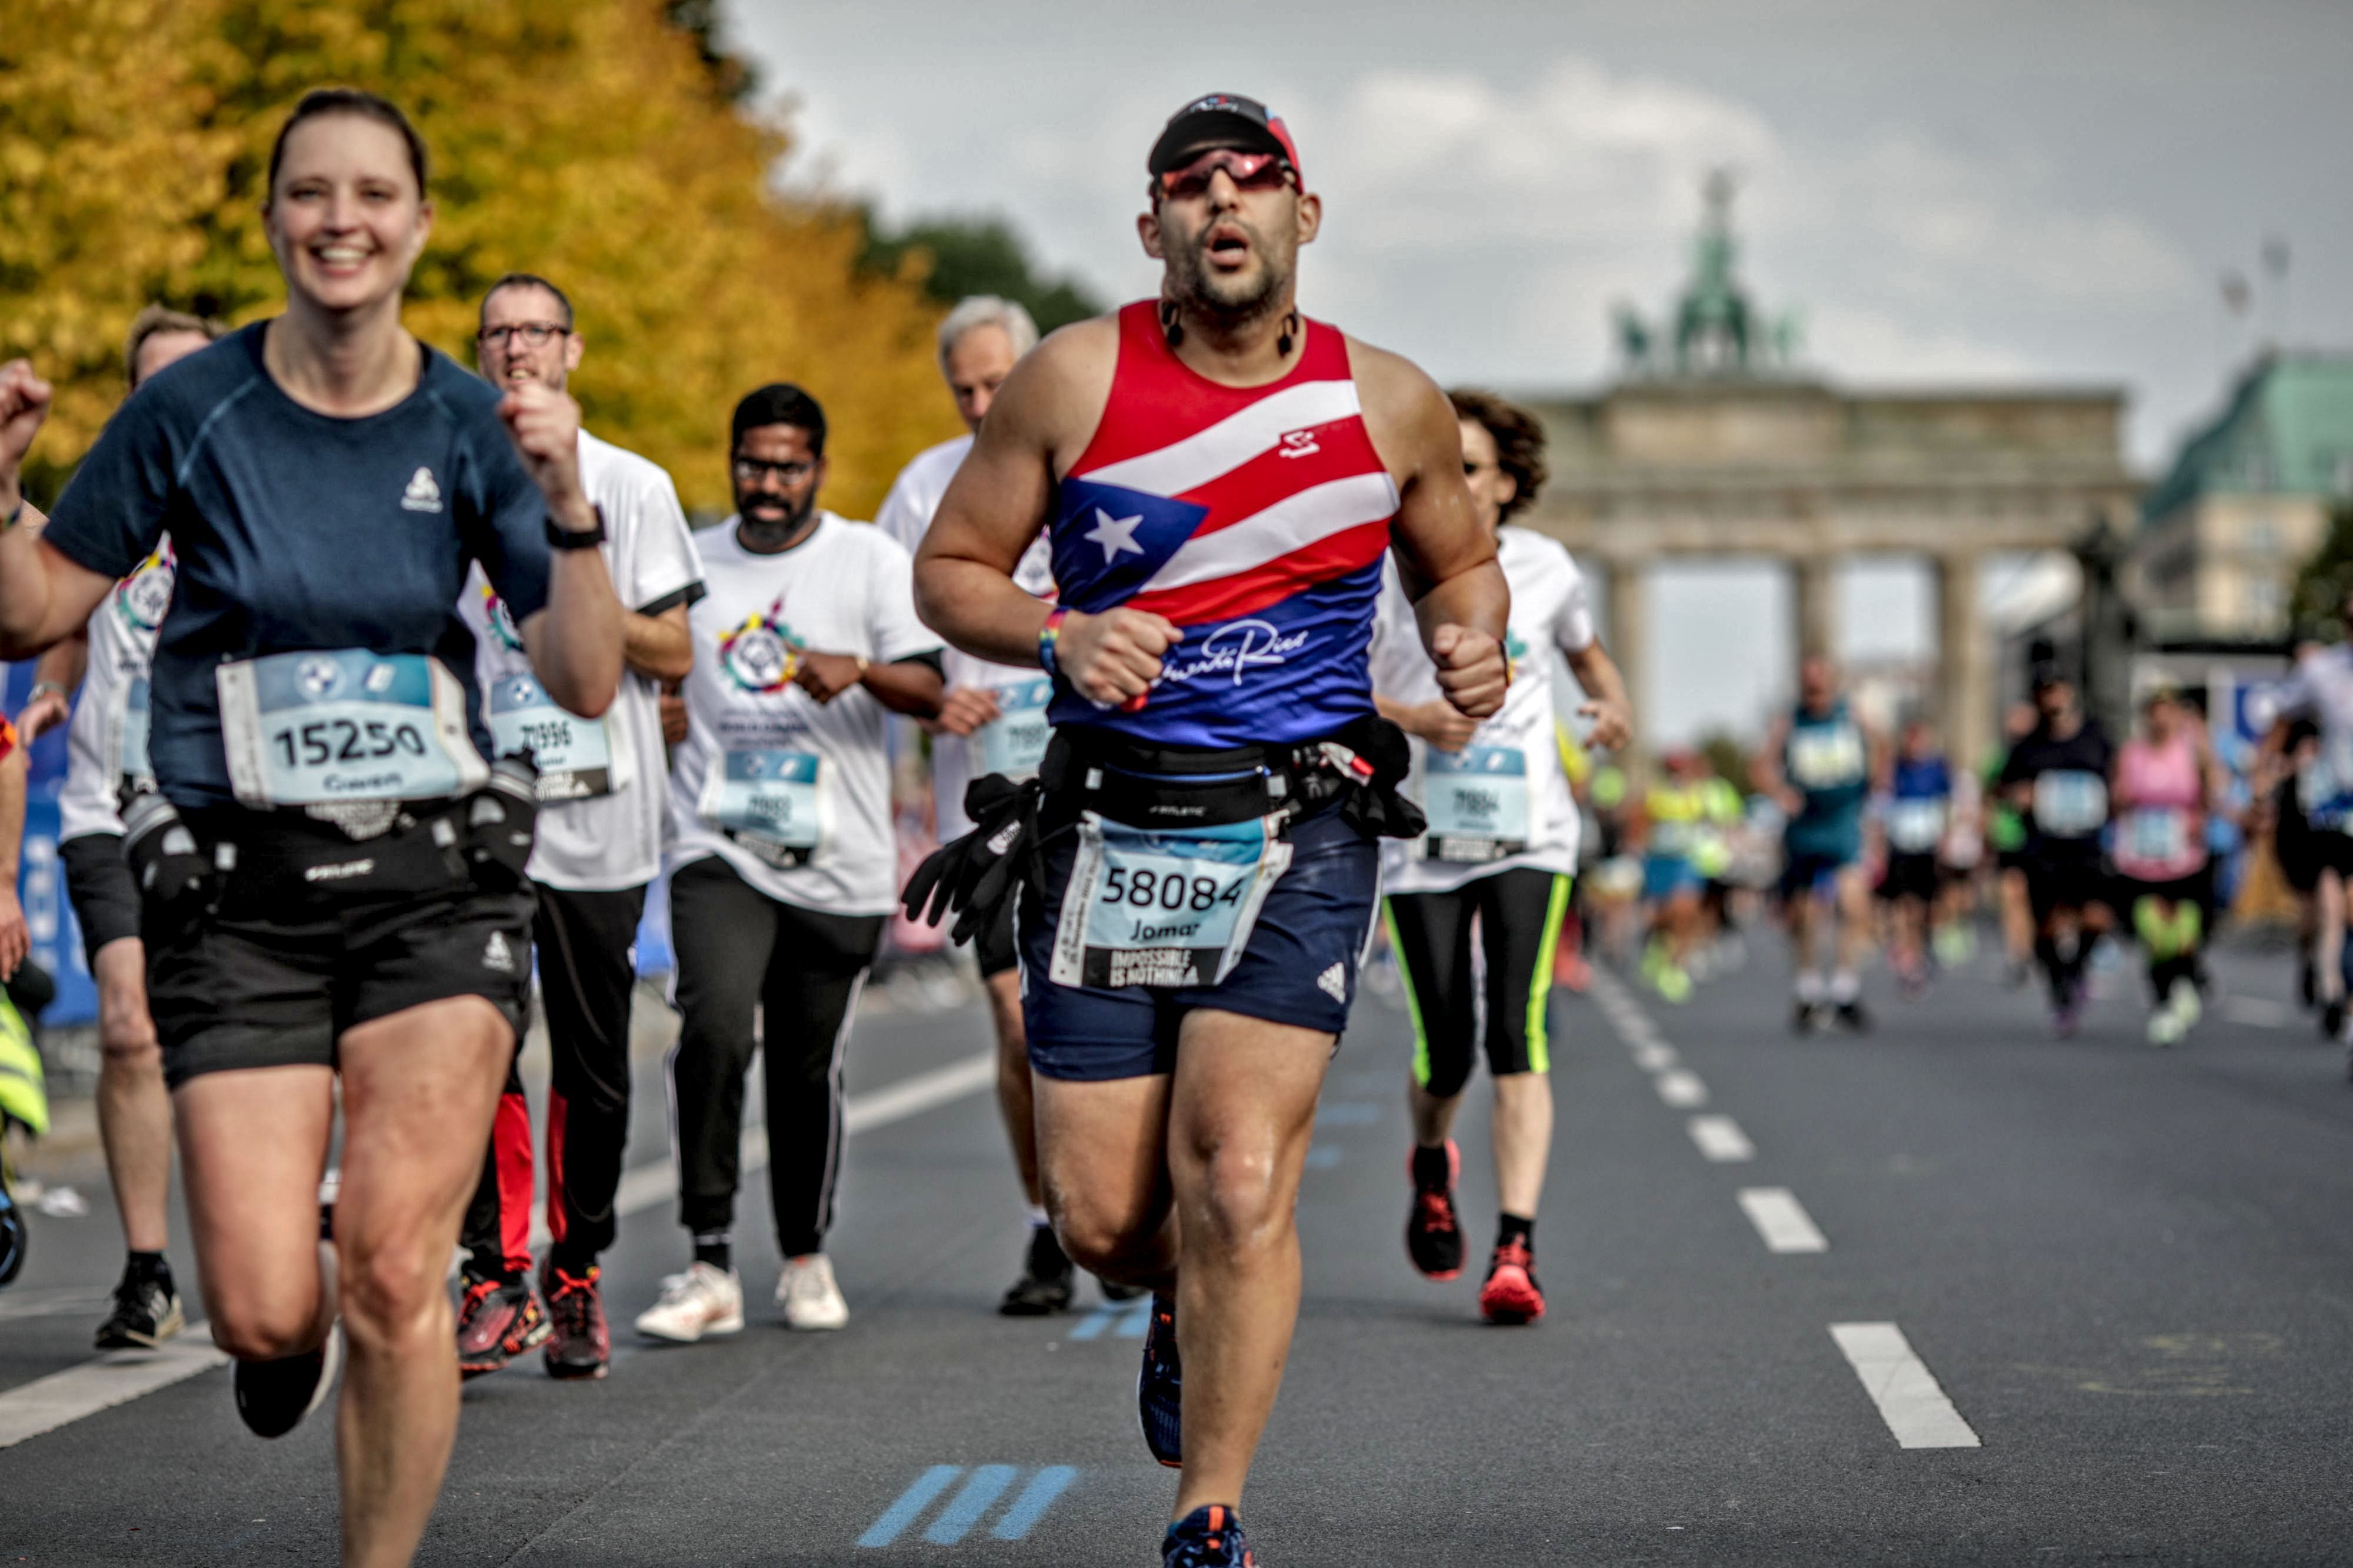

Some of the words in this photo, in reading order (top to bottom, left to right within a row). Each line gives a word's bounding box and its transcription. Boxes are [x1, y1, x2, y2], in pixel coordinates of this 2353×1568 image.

[274, 719, 426, 767] 15250
[1101, 867, 1243, 912] 58084
[1131, 919, 1201, 941] Jomar
